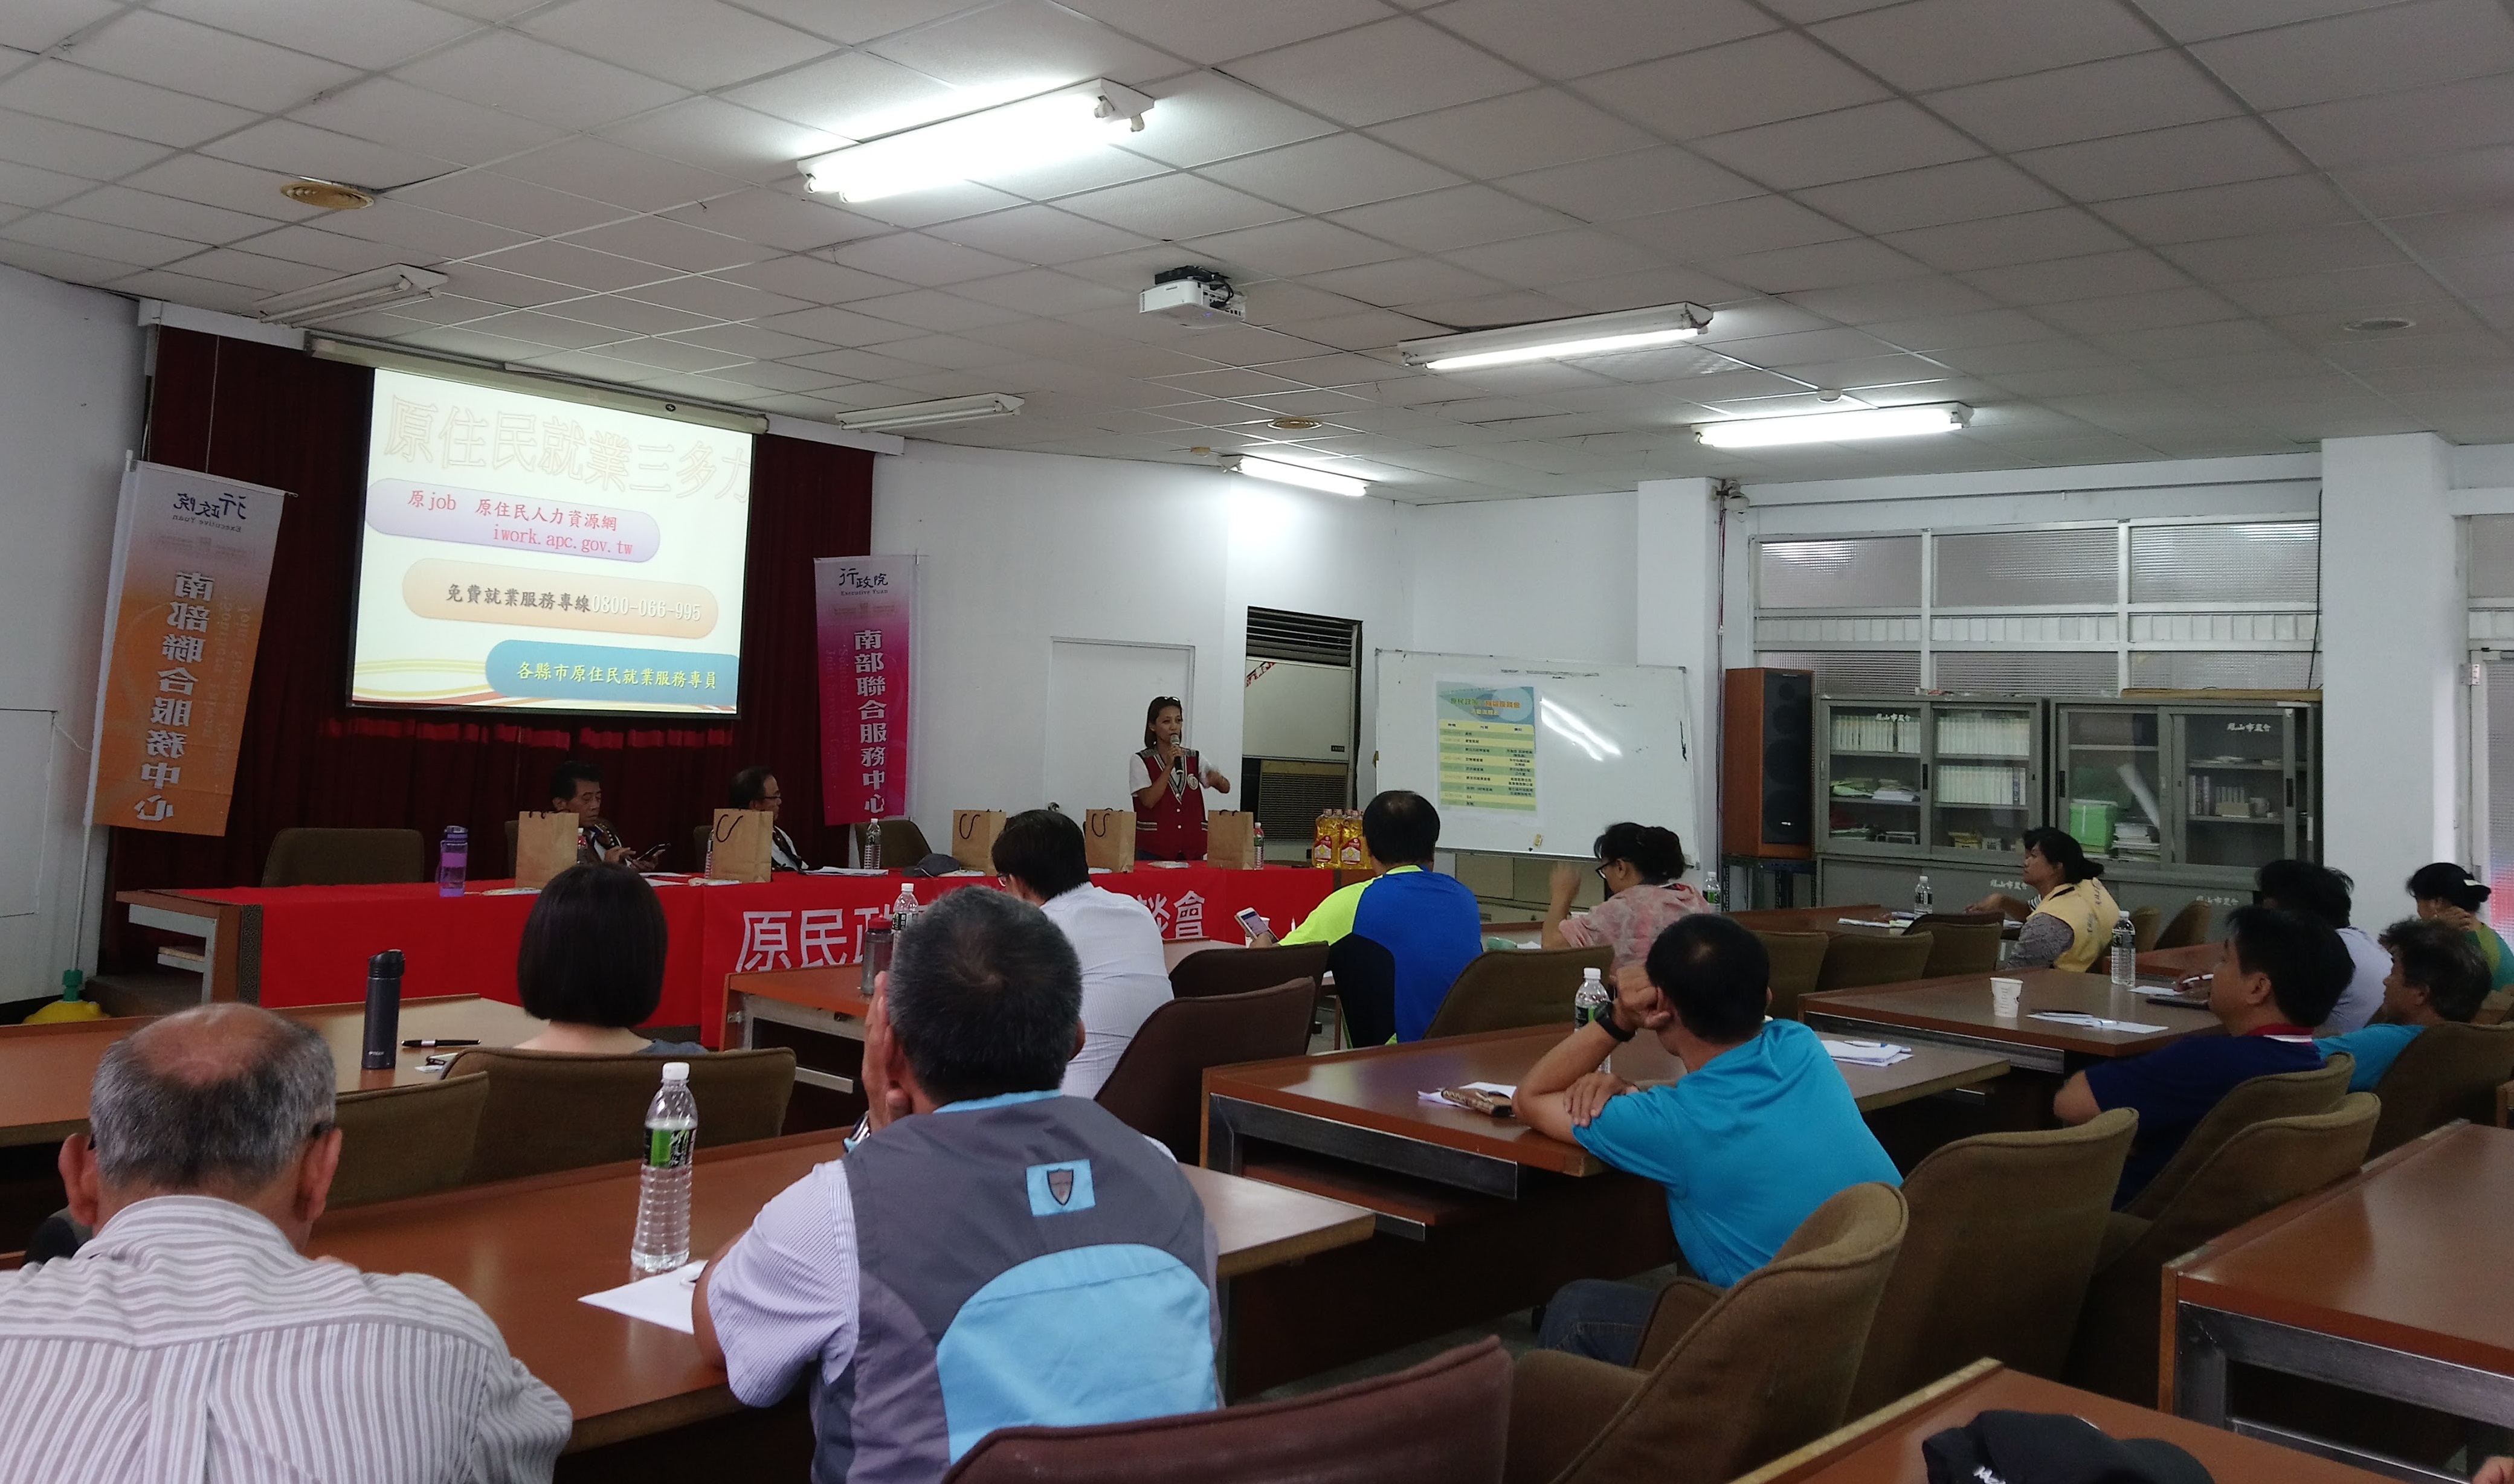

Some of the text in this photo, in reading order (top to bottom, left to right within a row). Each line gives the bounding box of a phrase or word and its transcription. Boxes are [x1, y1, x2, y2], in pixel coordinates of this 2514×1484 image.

[408, 490, 617, 532] 原job 原住民人力資源網
[492, 524, 633, 555] iwork.apc.gov.tw
[839, 568, 888, 588] 行政院
[517, 661, 717, 690] 各縣市原住民就業服務專員
[854, 629, 887, 813] 南部聯合服務中心
